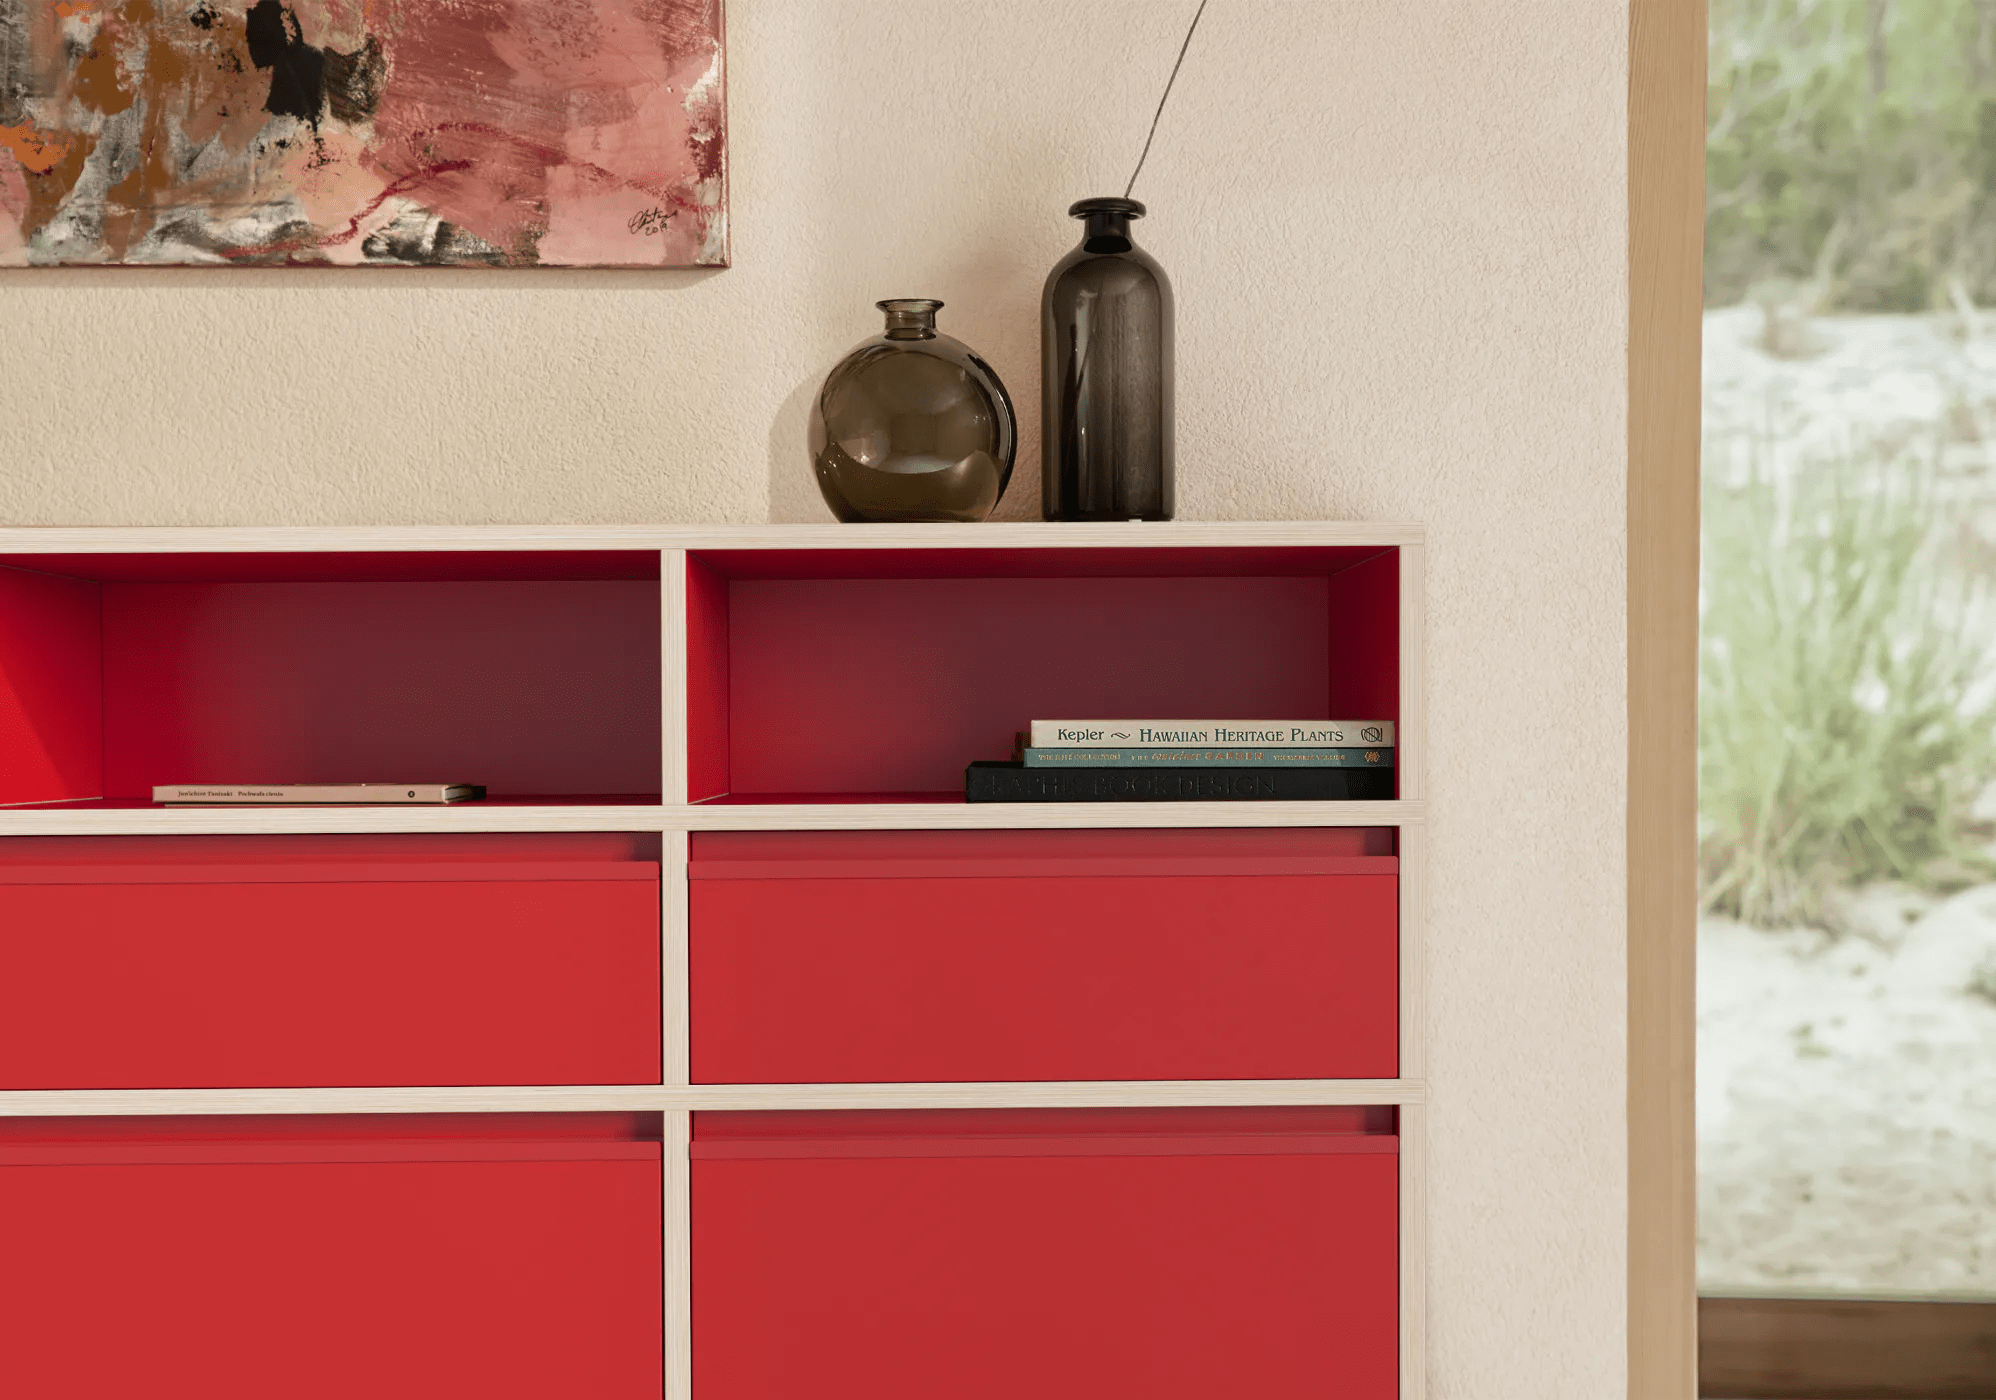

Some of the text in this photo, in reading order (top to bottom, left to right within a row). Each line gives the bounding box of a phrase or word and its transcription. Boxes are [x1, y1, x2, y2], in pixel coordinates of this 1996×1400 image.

[1058, 728, 1344, 743] Kepler HAWAIIAN HERITAGE PLANTS
[1205, 751, 1264, 761] GARDEN
[1178, 776, 1276, 795] DESIGN
